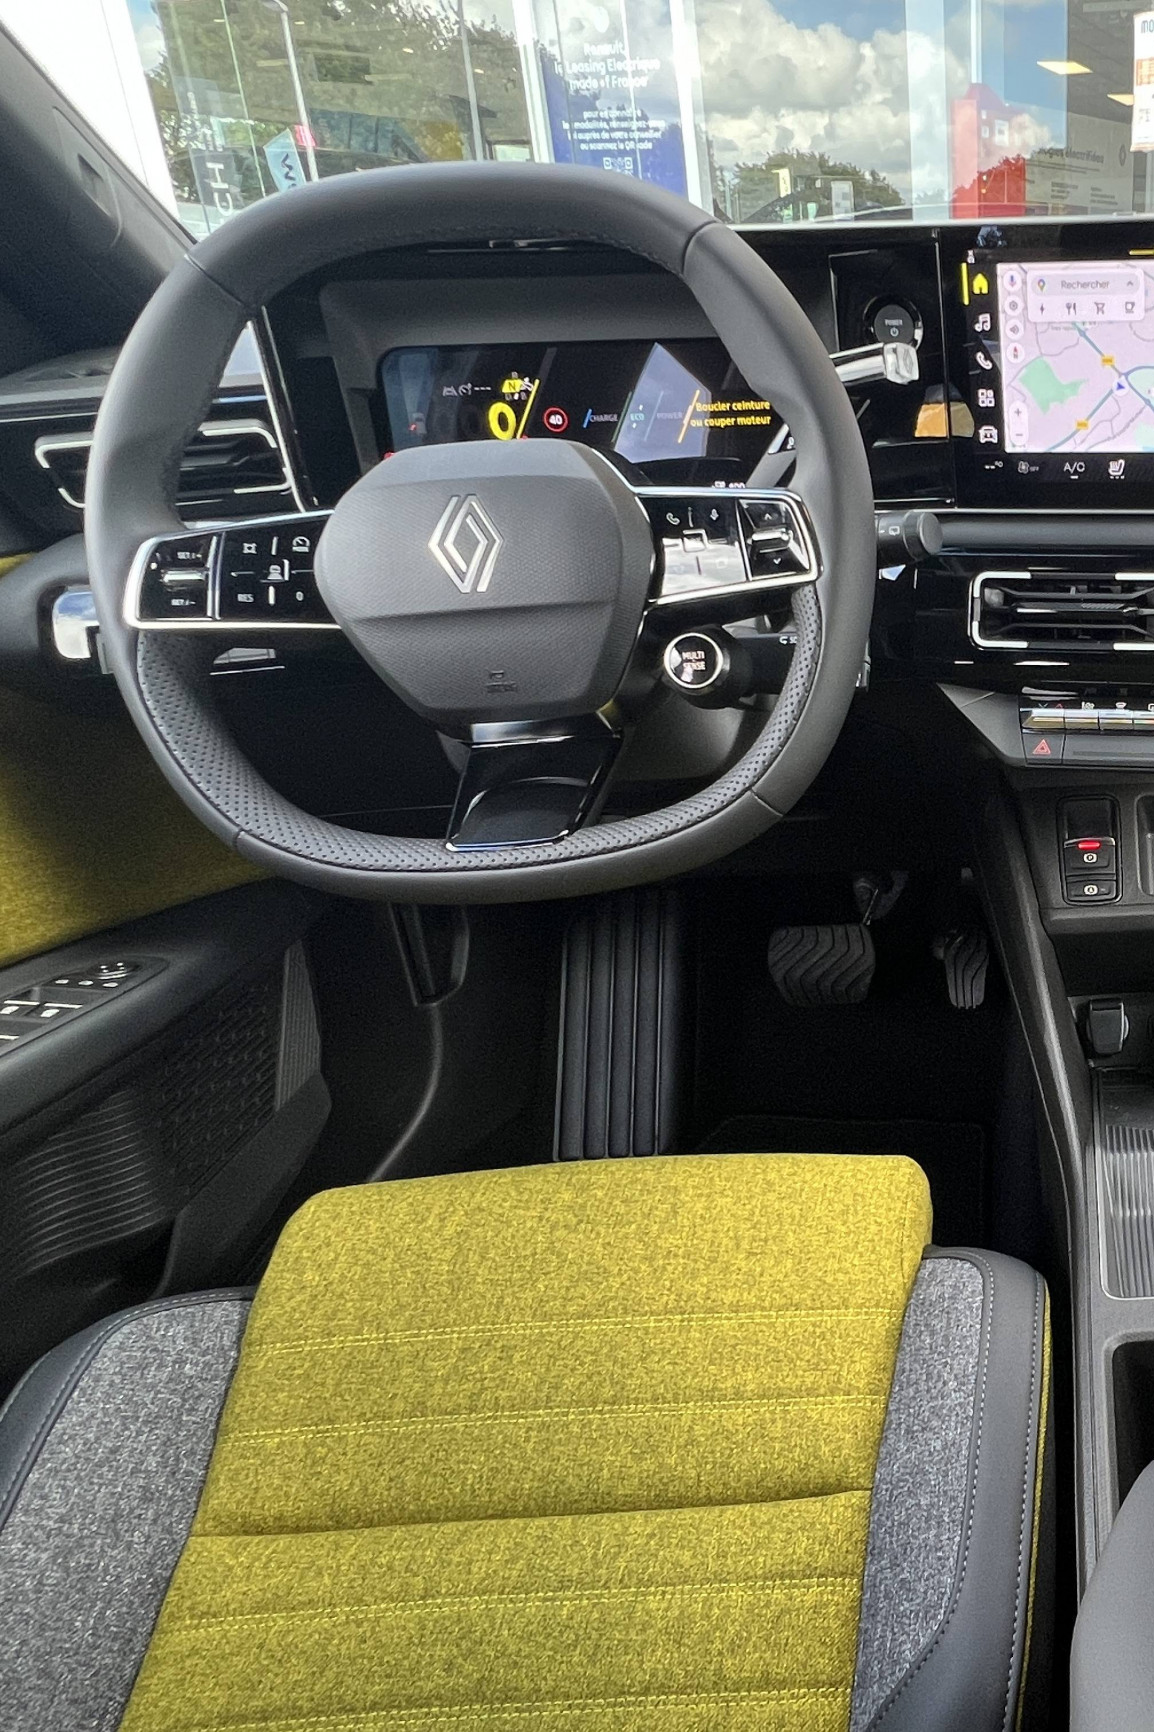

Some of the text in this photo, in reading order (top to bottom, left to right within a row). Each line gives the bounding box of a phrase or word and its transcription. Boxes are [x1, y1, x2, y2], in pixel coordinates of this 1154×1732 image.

[565, 58, 606, 75] Leasing
[569, 76, 599, 91] made
[1060, 279, 1110, 290] Rechercher
[695, 400, 771, 411] Boucler ceinture
[488, 402, 517, 441] 0
[549, 414, 563, 426] 40
[630, 412, 645, 421] ECO
[690, 415, 771, 429] ou couper moteur
[681, 650, 705, 660] MULTI
